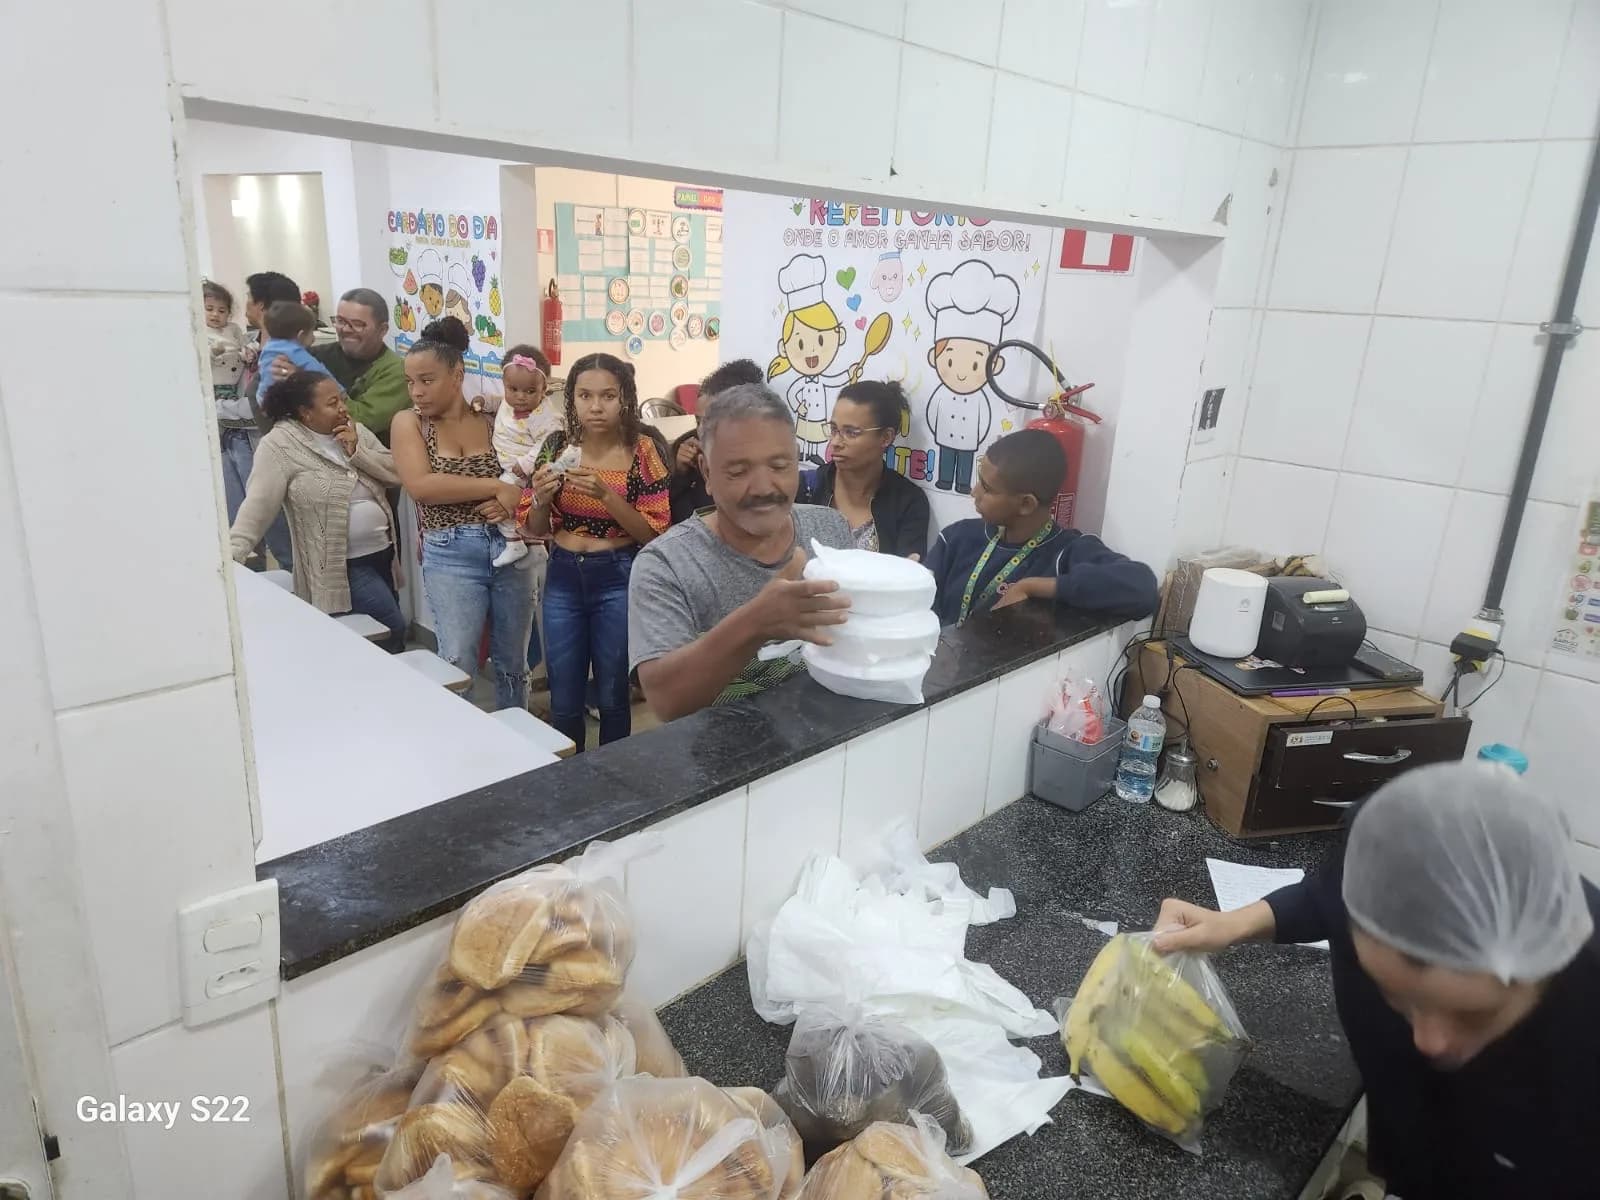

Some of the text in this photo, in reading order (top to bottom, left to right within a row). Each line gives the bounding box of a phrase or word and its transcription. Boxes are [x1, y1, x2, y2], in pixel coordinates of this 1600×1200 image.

[448, 214, 468, 239] DO
[473, 215, 498, 240] DIA
[783, 228, 1032, 252] ONDE O AMOR GANHA SABOR!
